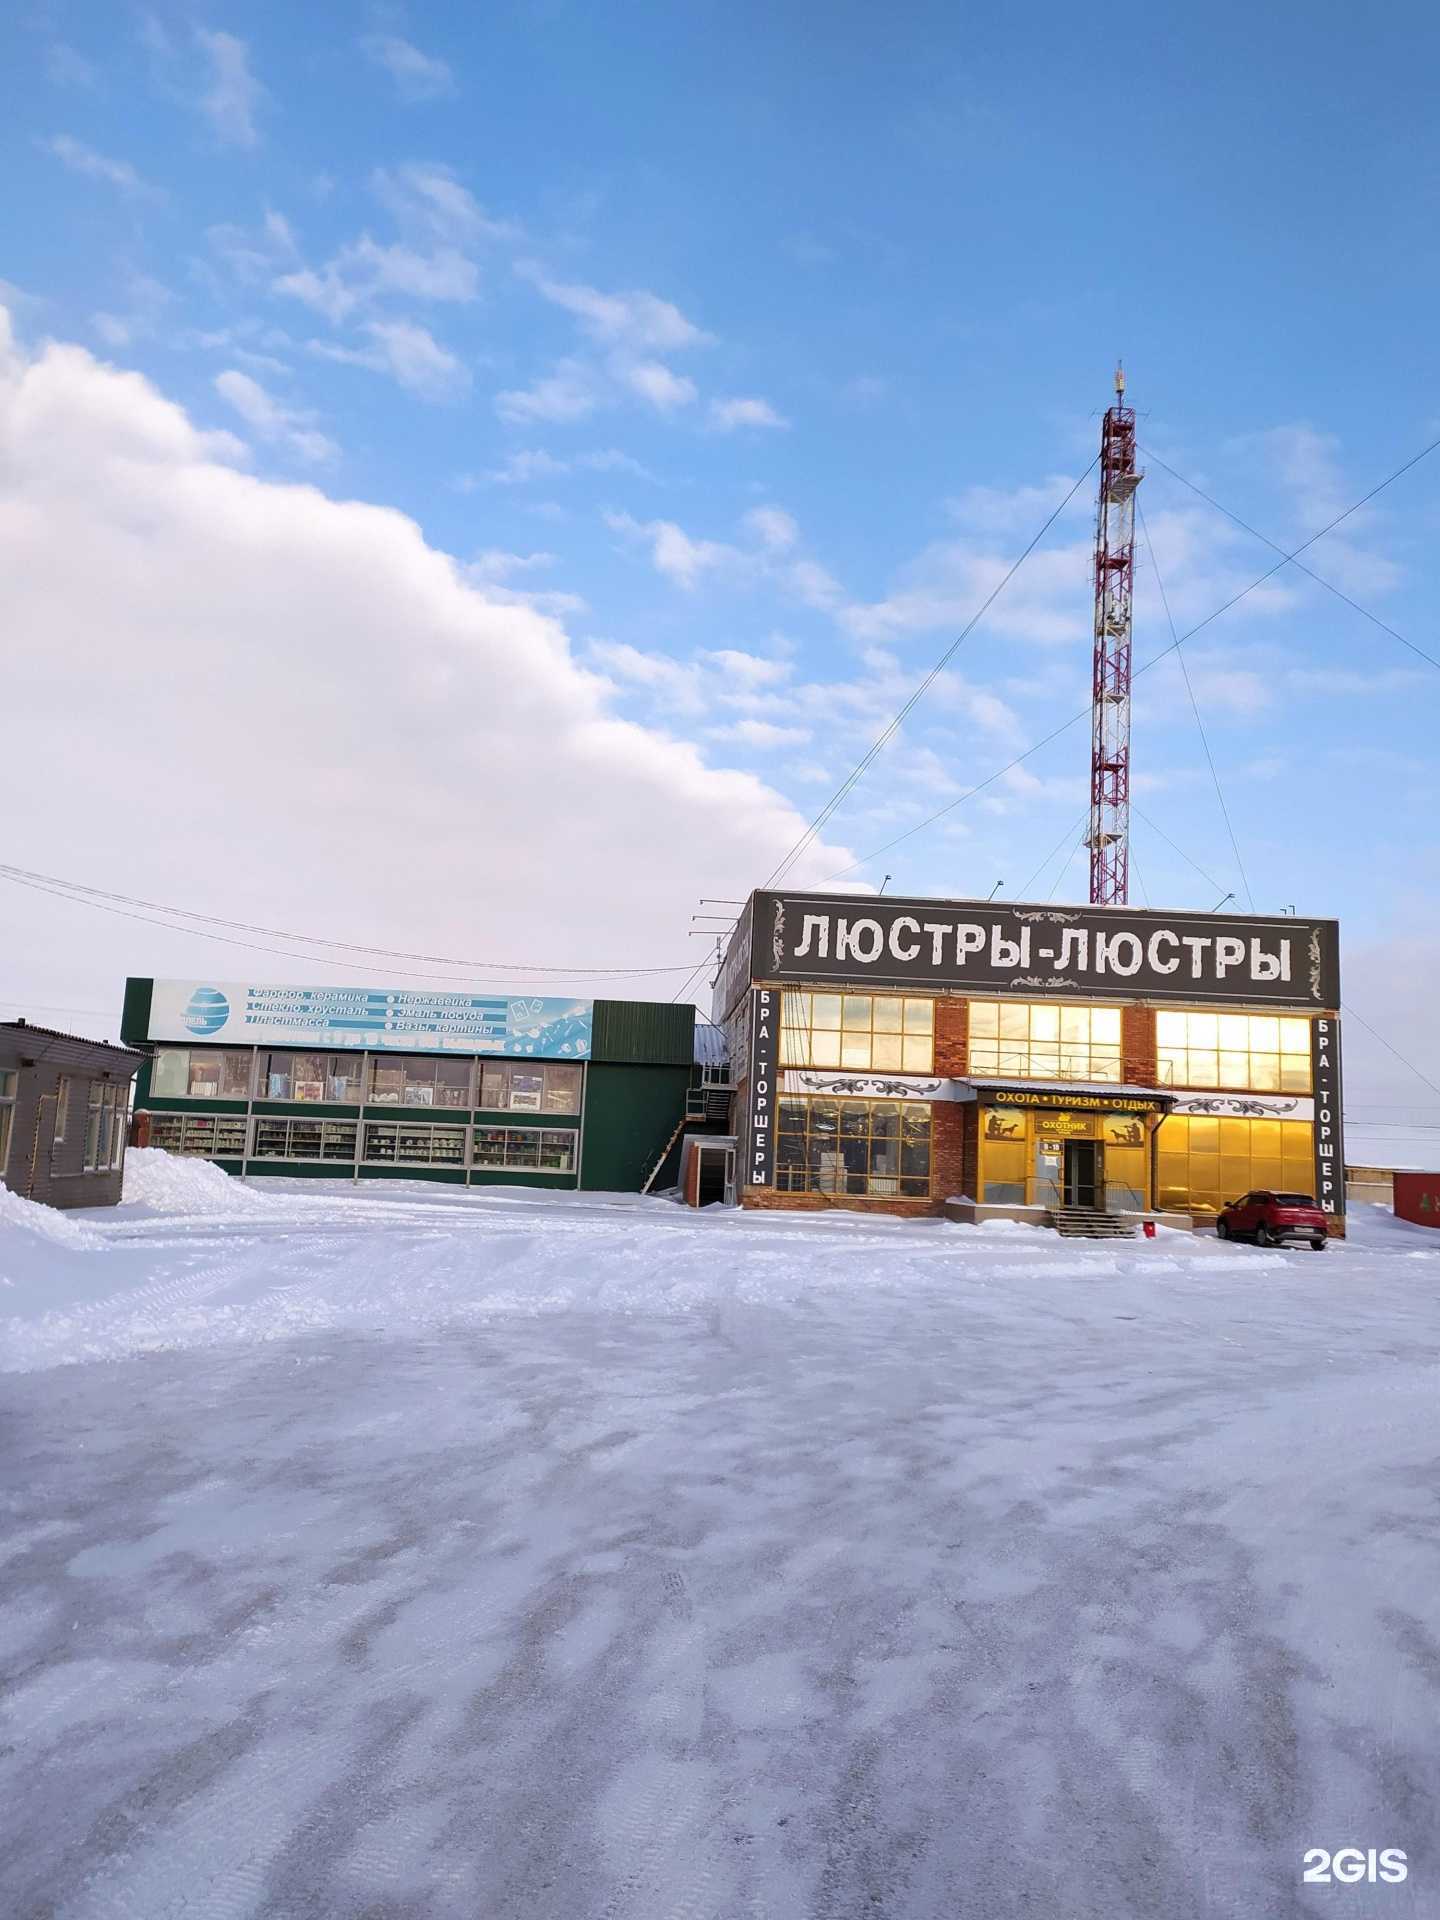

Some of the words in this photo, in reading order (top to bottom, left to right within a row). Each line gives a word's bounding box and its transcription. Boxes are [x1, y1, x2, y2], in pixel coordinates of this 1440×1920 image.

[794, 914, 1291, 982] ЛЮСТРЫ-ЛЮСТРЫ
[311, 990, 369, 1003] керамика
[398, 994, 472, 1007] Нержавейка
[308, 1005, 369, 1017] хрусталь
[398, 1009, 438, 1019] Эмаль
[441, 1010, 484, 1021] посуда
[249, 1015, 330, 1028] Пластмасса
[437, 1023, 494, 1035] картины
[996, 1091, 1040, 1104] ОХОТА
[1052, 1094, 1100, 1107] ТУРИЗМ
[1112, 1098, 1156, 1111] ОТДЫХ
[1042, 1121, 1087, 1130] ОХОТНИК
